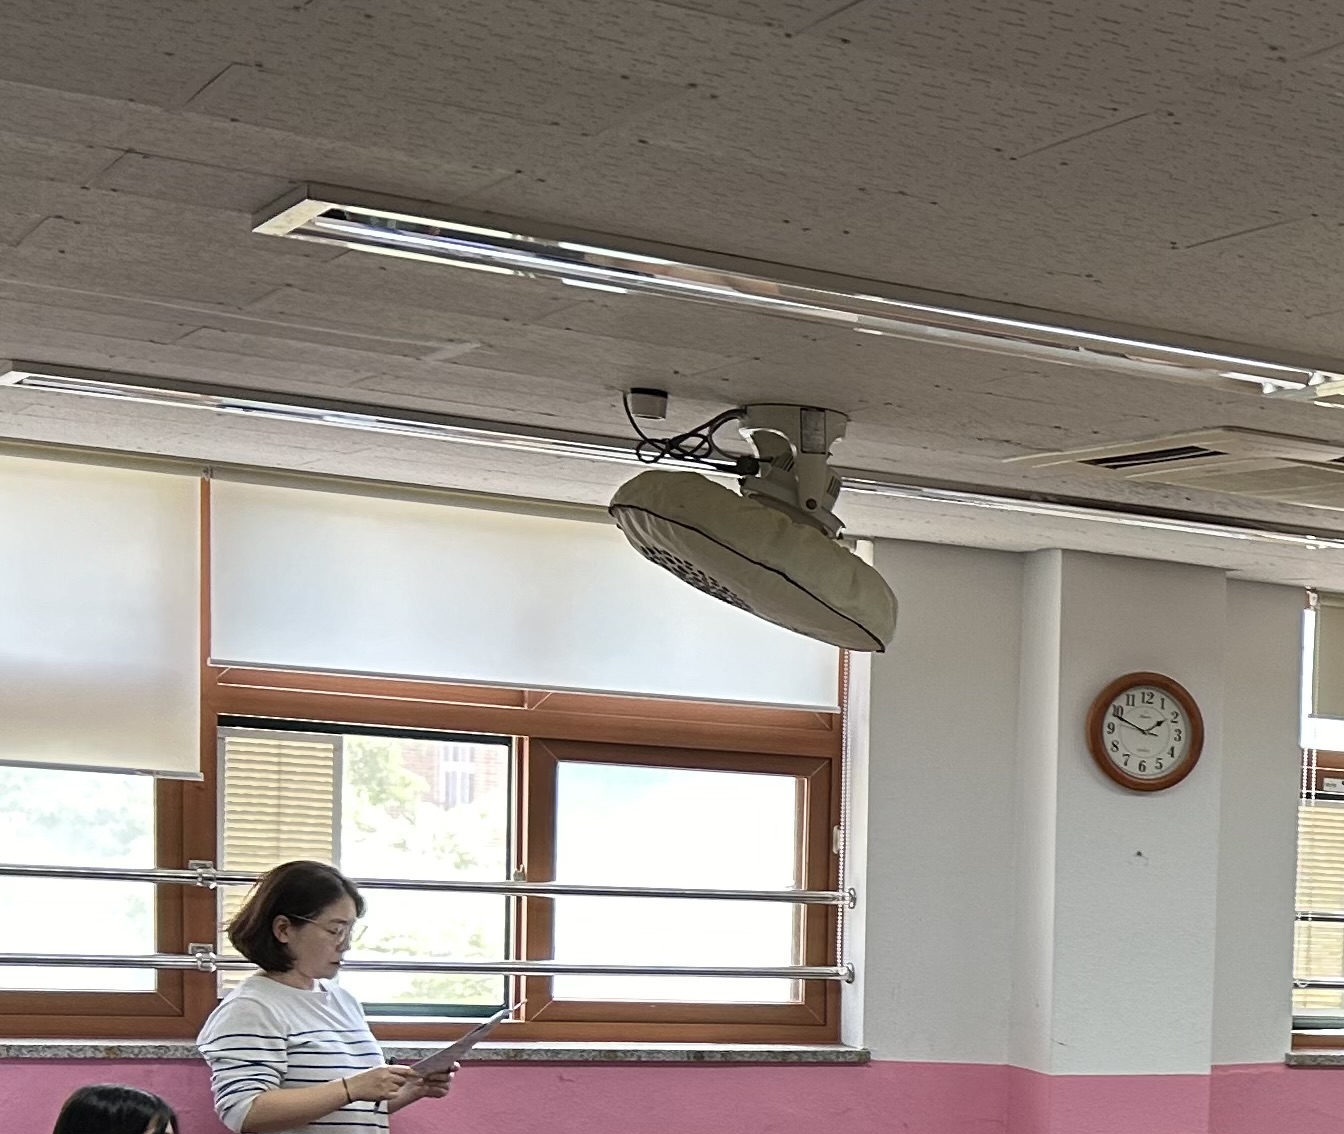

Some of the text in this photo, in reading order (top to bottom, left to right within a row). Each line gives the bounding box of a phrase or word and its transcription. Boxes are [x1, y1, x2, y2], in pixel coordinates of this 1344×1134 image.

[1125, 693, 1136, 707] 11
[1141, 691, 1155, 705] 12
[1160, 697, 1166, 710] 1
[1112, 703, 1124, 718] 10
[1170, 710, 1179, 724] 2
[1106, 721, 1116, 735] 9
[1173, 728, 1182, 742] 3
[1110, 739, 1119, 753] 8
[1167, 745, 1175, 758] 4
[1122, 753, 1131, 767] 7
[1138, 759, 1147, 773] 6
[1154, 757, 1163, 770] 5
